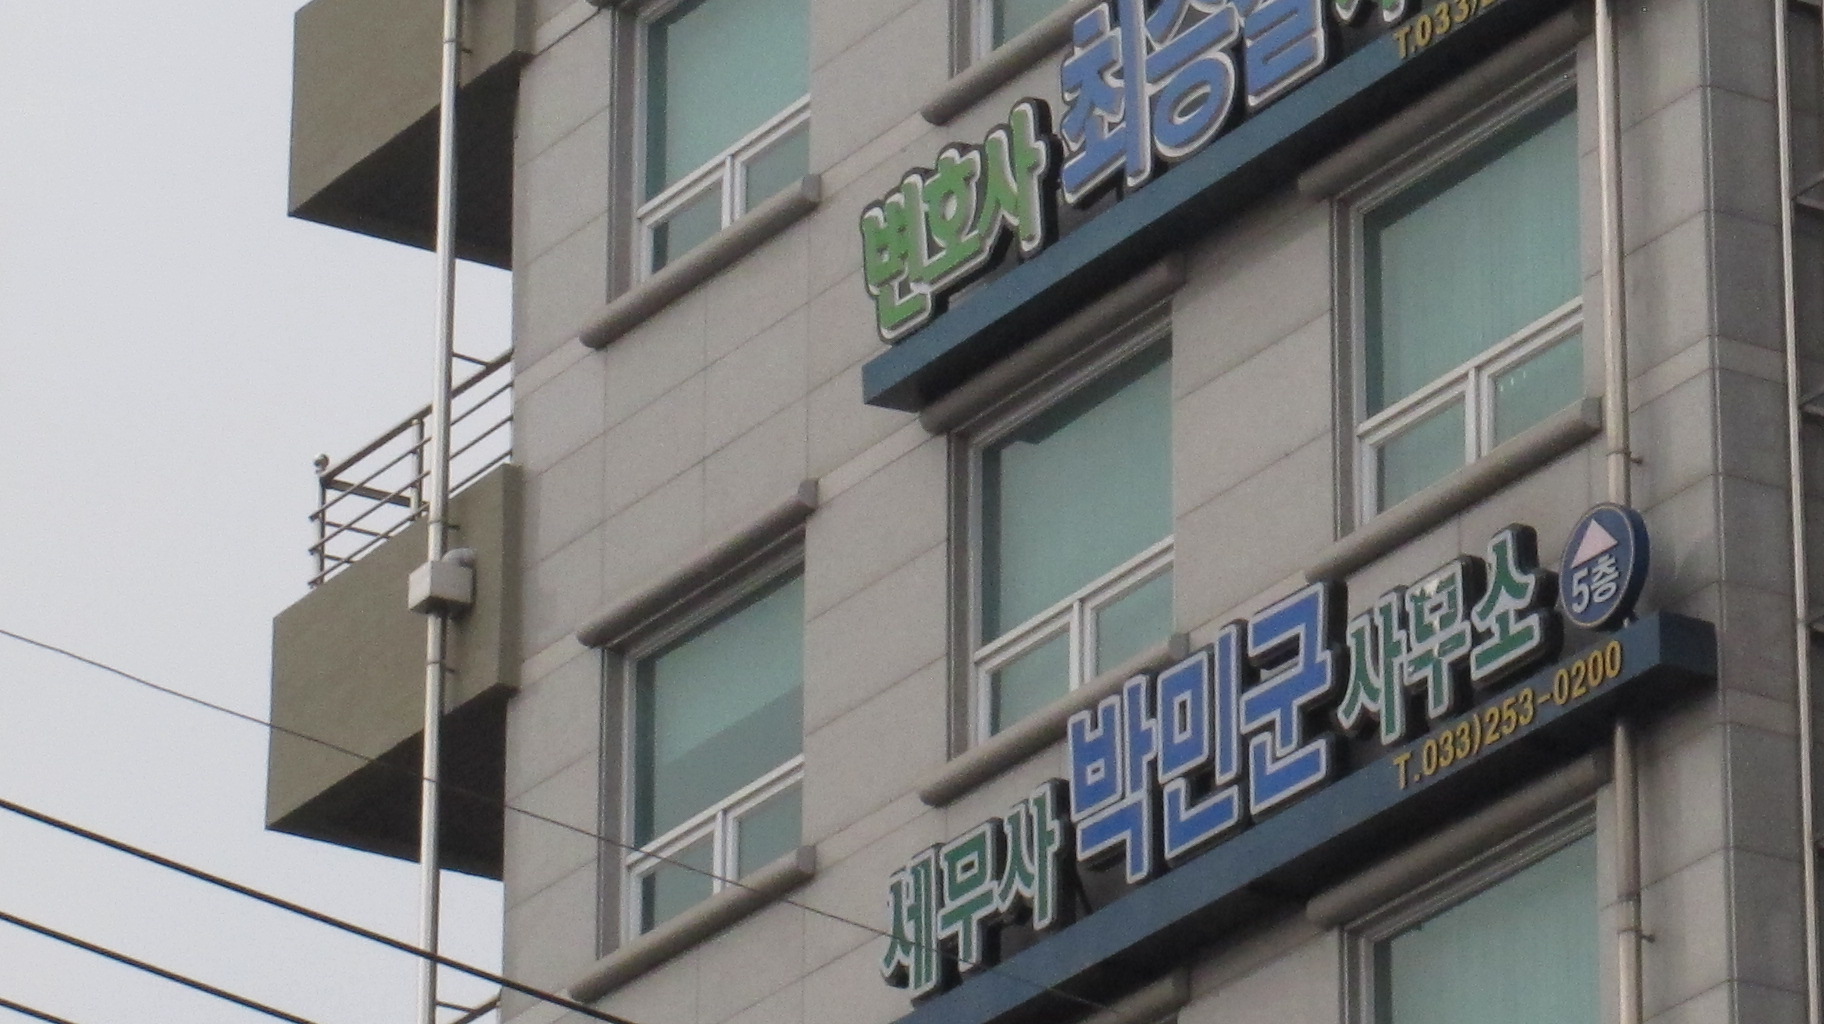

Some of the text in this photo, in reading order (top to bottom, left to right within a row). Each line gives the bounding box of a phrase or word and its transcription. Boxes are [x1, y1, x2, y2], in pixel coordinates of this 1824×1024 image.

[861, 98, 1047, 341] 변호사
[1571, 553, 1620, 614] 5층
[881, 528, 1542, 1000] 세무사 박민군 사무소
[1393, 640, 1624, 800] T.033)253-0200
